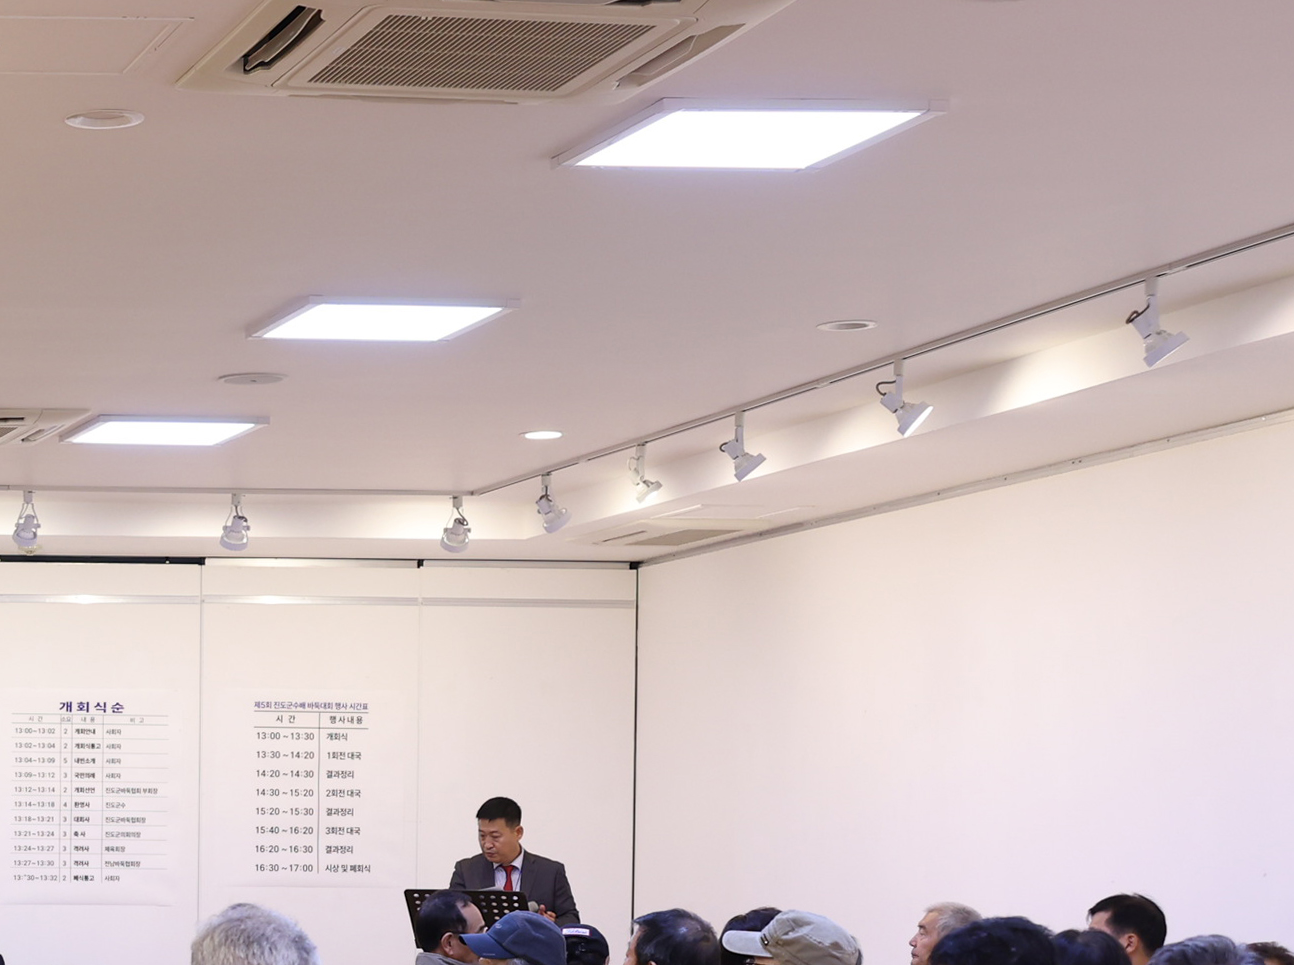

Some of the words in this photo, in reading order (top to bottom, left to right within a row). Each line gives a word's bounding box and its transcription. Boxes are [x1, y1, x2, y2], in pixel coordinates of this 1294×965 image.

[253, 700, 273, 709] 제5회
[273, 701, 307, 710] 진도군수배
[306, 701, 334, 710] 바둑대회
[334, 702, 348, 711] 행사
[348, 702, 369, 711] 시간표
[15, 727, 56, 735] 13:00~13:02
[63, 727, 68, 735] 2
[105, 728, 122, 736] 사회자
[256, 731, 281, 740] 13:00
[290, 731, 315, 741] 13:30
[326, 732, 348, 741] 개회식
[15, 741, 56, 749] 13:02~13:04
[63, 742, 68, 750] 2
[256, 750, 281, 759] 13:30
[290, 751, 315, 760] 14:20
[327, 751, 346, 761] 1회전
[346, 751, 362, 760] 대국
[14, 756, 56, 764] 13:04~13:09
[105, 757, 122, 765] 사회자
[14, 771, 56, 779] 13:09~13:12
[63, 771, 68, 779] 3
[256, 769, 281, 778] 14:20
[290, 769, 315, 779] 14:30
[326, 769, 355, 779] 결과정리
[63, 786, 68, 794] 2
[256, 788, 280, 797] 14:30
[289, 788, 314, 798] 15:20
[325, 788, 346, 798] 2회전
[346, 789, 362, 798] 대국
[105, 801, 127, 809] 진도군수
[255, 807, 281, 816] 15:20
[289, 807, 315, 817] 15:30
[325, 807, 354, 817] 결과정리
[14, 815, 55, 823] 13:18~13:21
[62, 815, 68, 823] 3
[14, 830, 55, 838] 13:21~13:24
[62, 830, 68, 838] 3
[255, 825, 280, 835] 15:40
[289, 826, 314, 835] 16:20
[325, 826, 345, 836] 3회전
[346, 826, 361, 836] 대국
[13, 844, 55, 852] 13:24~13:27
[255, 844, 280, 854] 16:20
[289, 844, 314, 854] 16:30
[325, 845, 354, 855] 결과정리
[13, 859, 55, 867] 13:27~13:30
[62, 859, 67, 867] 3
[255, 863, 280, 872] 16:30
[289, 863, 314, 873] 17:00
[324, 864, 340, 874] 시상
[340, 864, 348, 873] 및
[349, 864, 371, 873] 폐회식
[62, 874, 67, 882] 2
